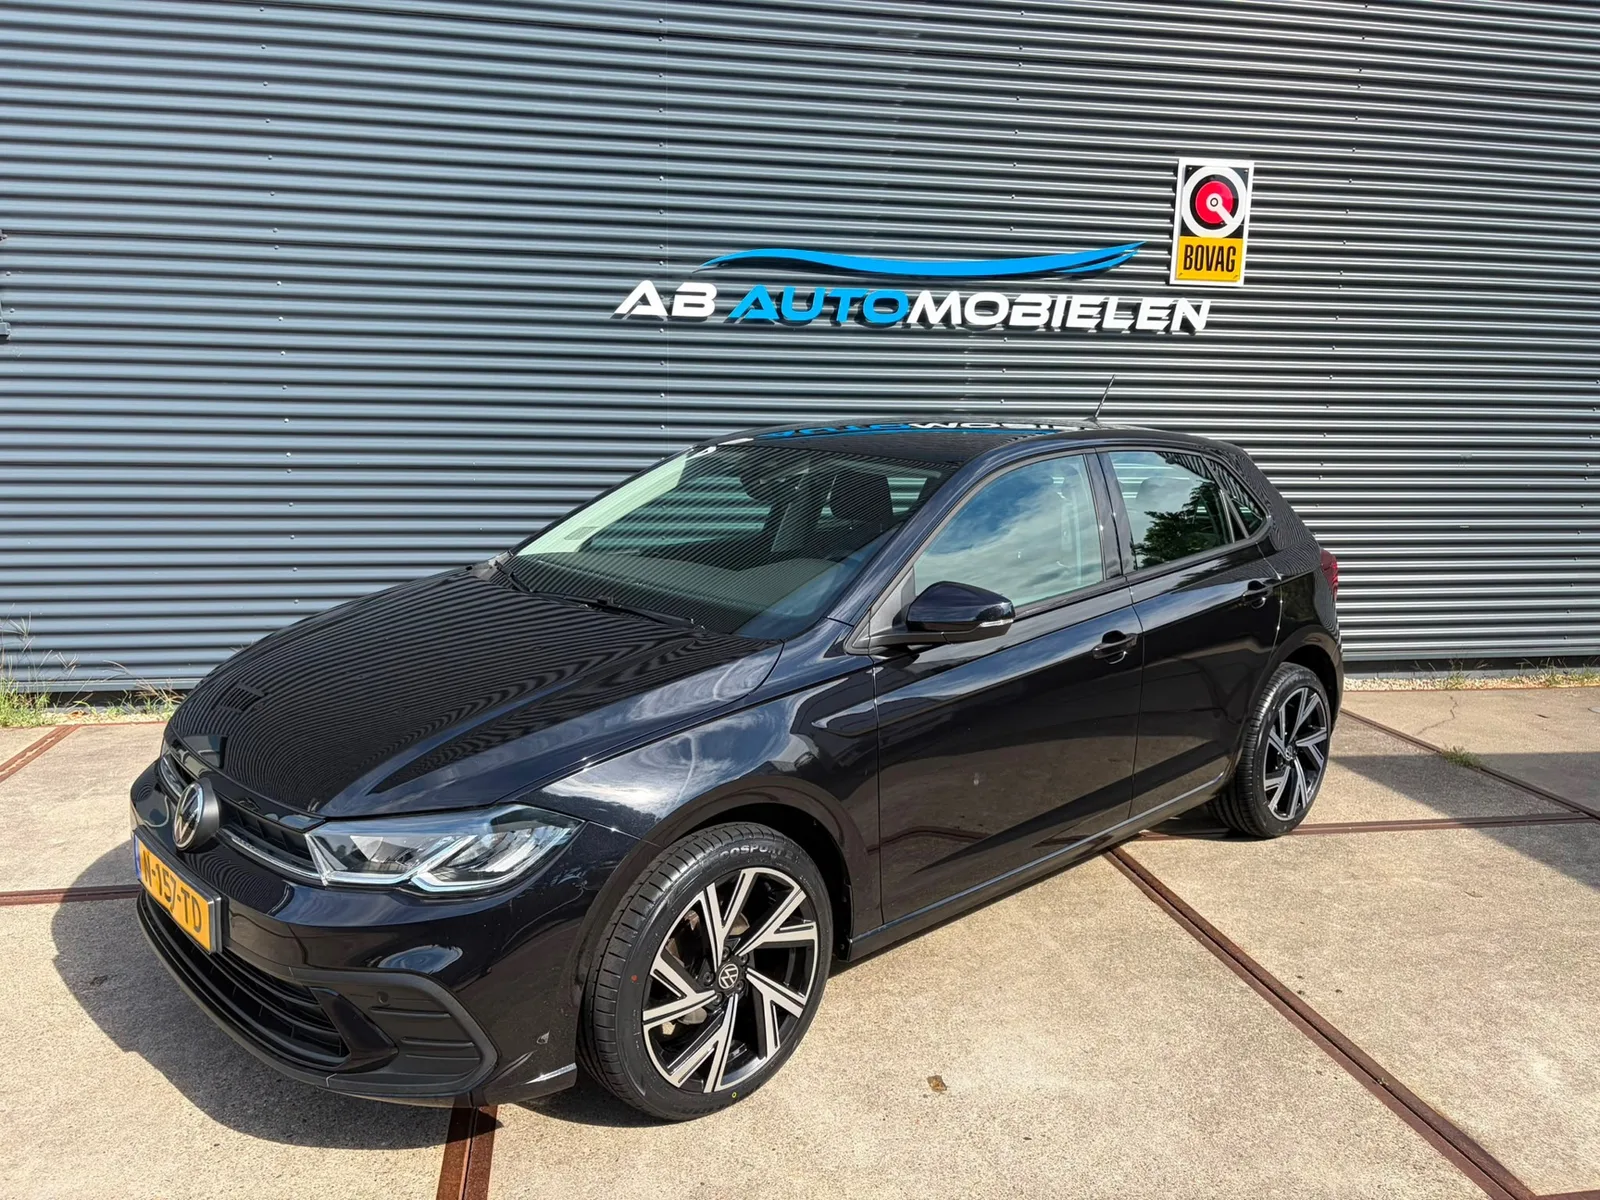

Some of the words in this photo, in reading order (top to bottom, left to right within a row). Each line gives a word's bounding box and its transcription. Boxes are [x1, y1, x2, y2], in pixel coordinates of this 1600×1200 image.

[1182, 244, 1237, 273] BOVAG
[613, 279, 718, 318] AB
[727, 283, 1212, 332] AUTOMOBIELEN
[141, 848, 203, 934] N-157-TD
